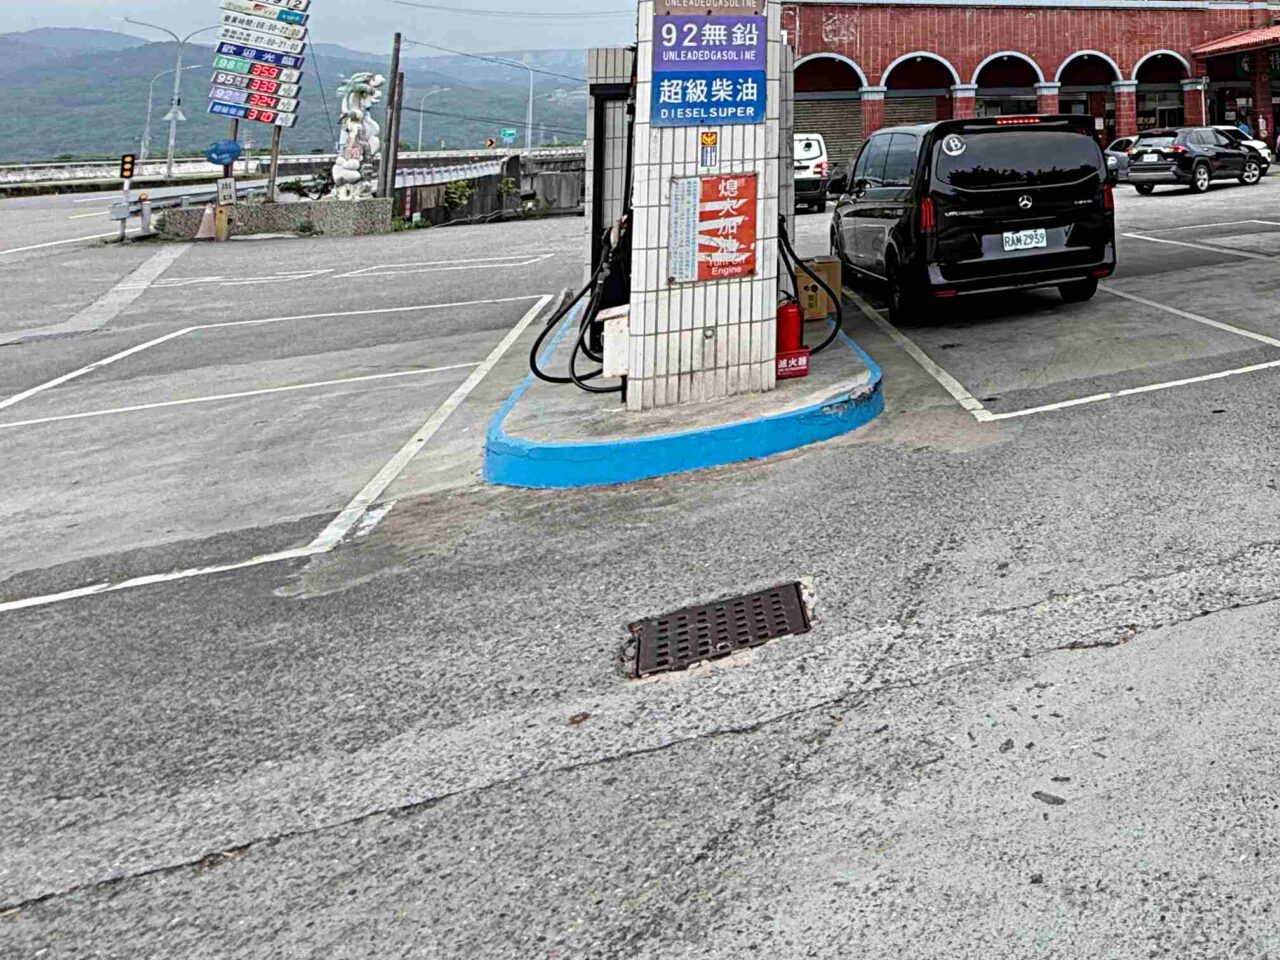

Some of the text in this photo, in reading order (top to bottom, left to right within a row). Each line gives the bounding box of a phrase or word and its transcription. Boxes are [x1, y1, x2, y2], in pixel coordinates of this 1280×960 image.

[660, 23, 759, 47] 92無鉛
[659, 78, 758, 104] 超級柴油
[711, 266, 742, 277] Engine
